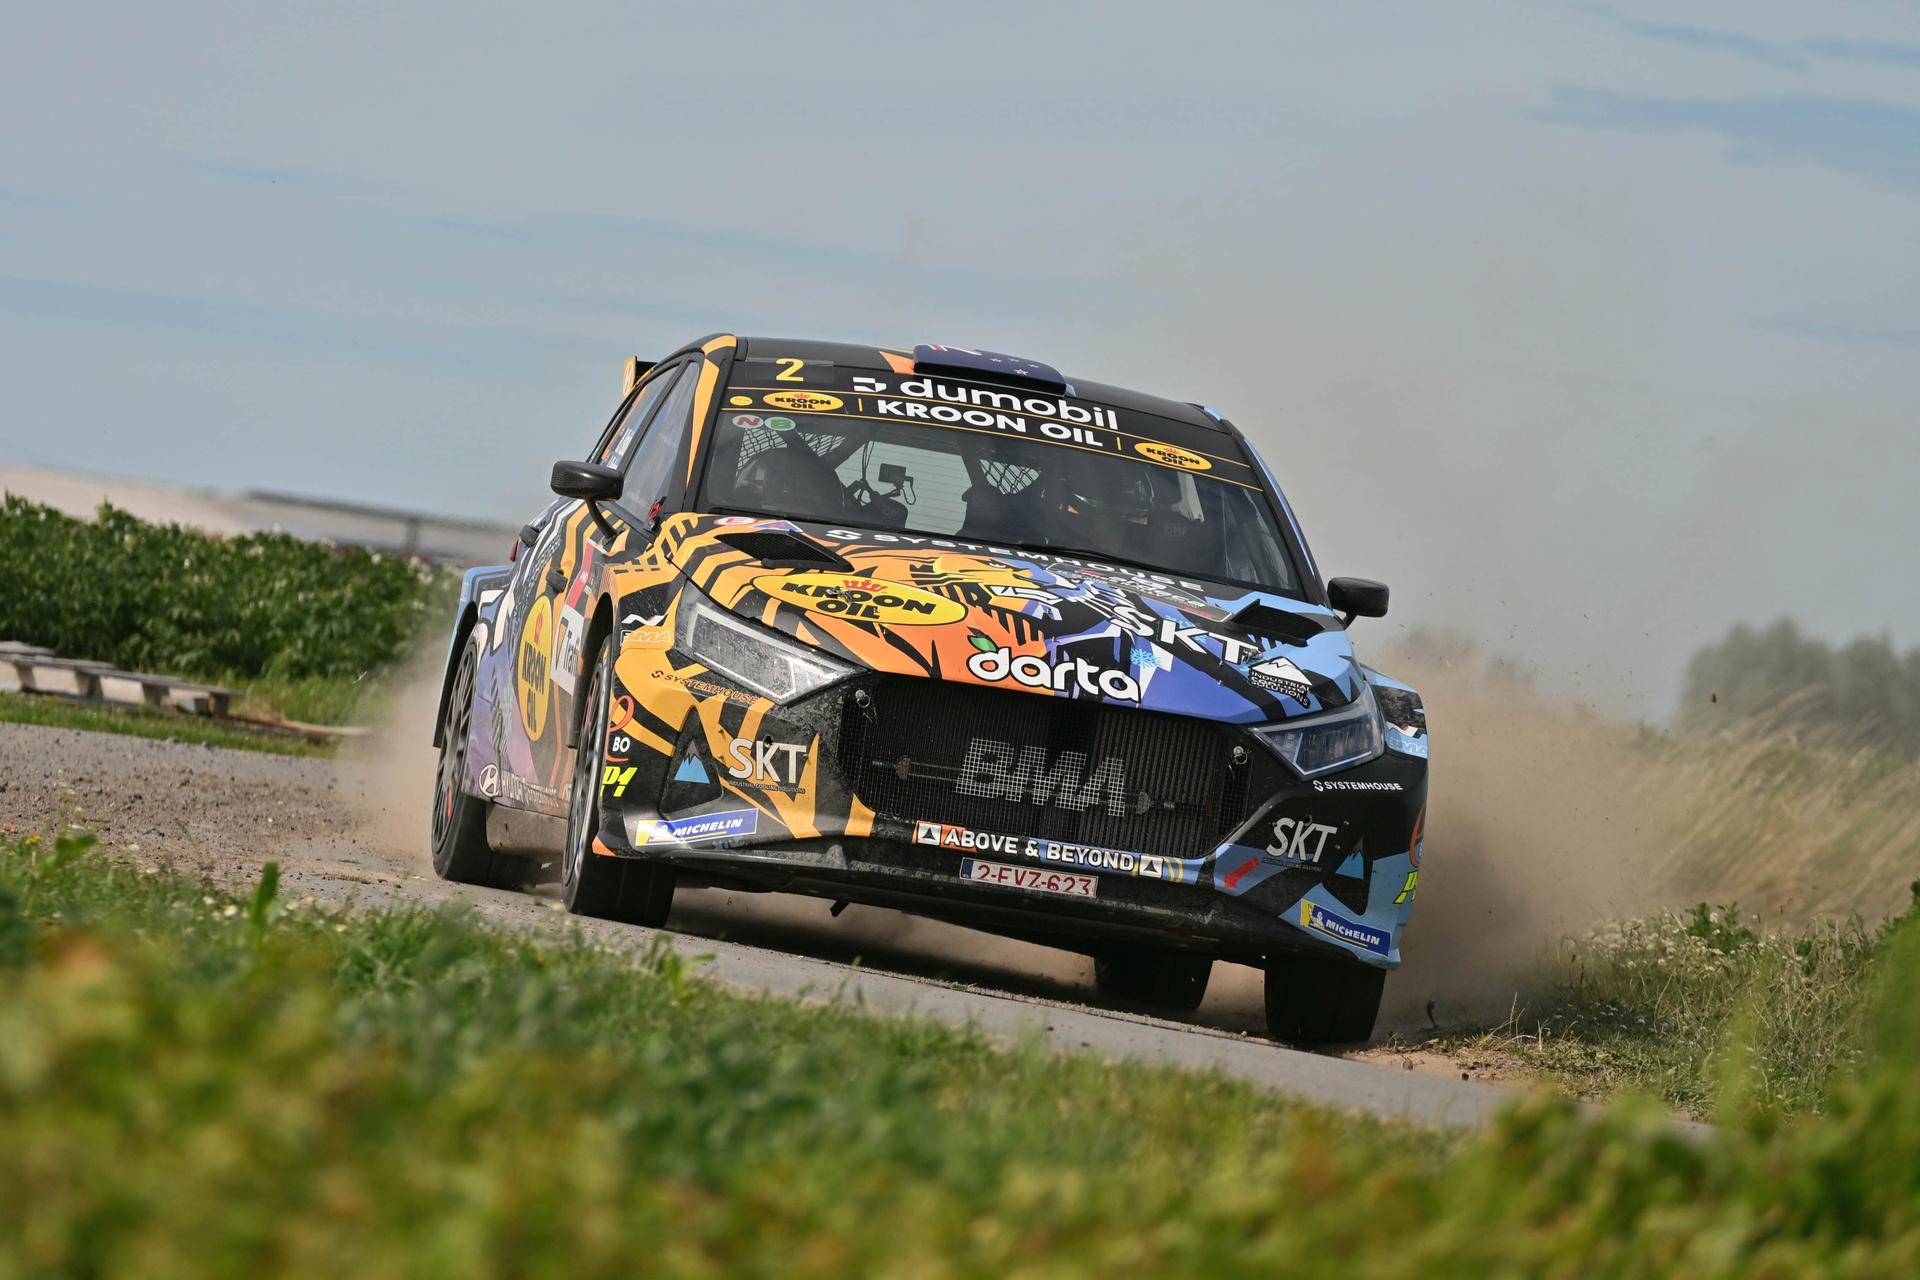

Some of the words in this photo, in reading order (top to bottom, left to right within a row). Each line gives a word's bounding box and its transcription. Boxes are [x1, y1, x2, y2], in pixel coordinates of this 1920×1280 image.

[776, 358, 804, 382] 2
[775, 397, 832, 406] KROON
[899, 378, 1118, 431] dumobil
[736, 416, 762, 427] N
[770, 418, 792, 429] B
[877, 399, 1027, 433] KROON
[1040, 423, 1103, 447] OIL
[1146, 447, 1201, 466] KROON
[1162, 457, 1186, 467] OIL
[873, 533, 1205, 592] SYSTEMHOUSE
[781, 582, 937, 616] KROON
[816, 600, 881, 620] OIL
[1110, 606, 1259, 664] SKT
[664, 674, 760, 704] SYSTEMHOUSE
[967, 646, 1142, 703] darta
[728, 738, 807, 784] SKT
[954, 737, 1127, 817] BMA
[1323, 781, 1404, 791] SYSTEMHOUSE
[673, 818, 744, 836] MICHELIN
[1266, 817, 1338, 863] SKT
[944, 828, 1019, 854] ABOVE
[1025, 840, 1040, 858] &
[1047, 843, 1135, 871] BEYOND
[1325, 918, 1381, 946] MICHELIN
